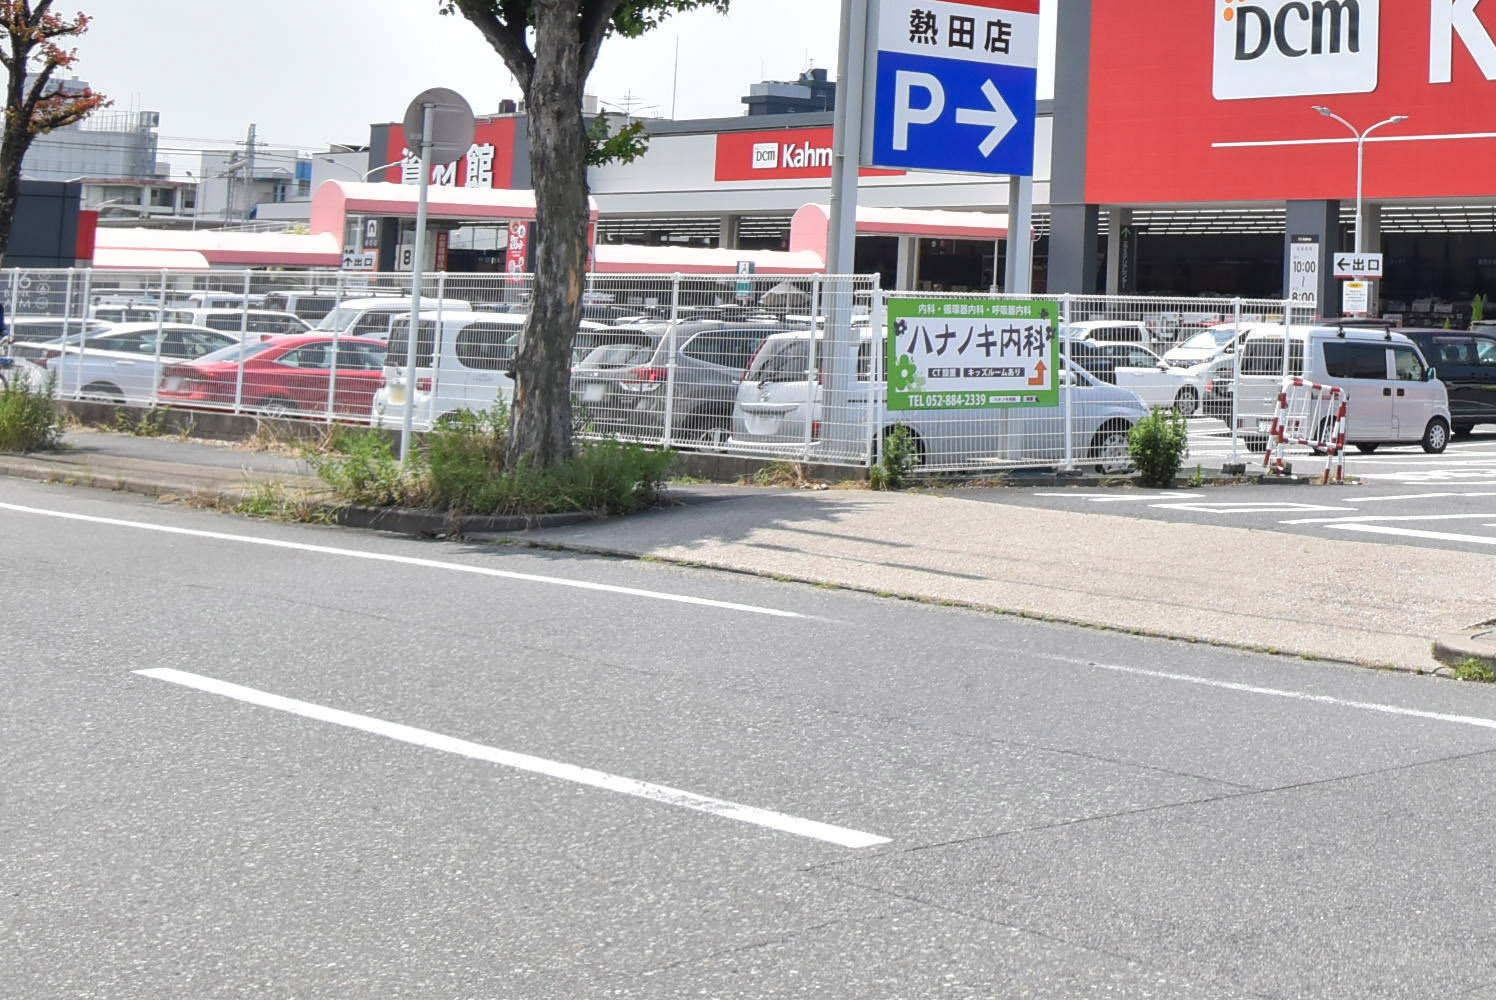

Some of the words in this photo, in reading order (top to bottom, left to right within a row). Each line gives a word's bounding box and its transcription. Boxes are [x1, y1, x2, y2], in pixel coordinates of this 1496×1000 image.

[909, 8, 1012, 55] 熱田店
[892, 69, 946, 151] P
[1293, 260, 1316, 273] 10:00
[1352, 258, 1380, 271] 出口
[907, 323, 1045, 358] ハナノキ内科
[908, 395, 925, 407] TEL
[925, 393, 986, 407] 052-884-2339
